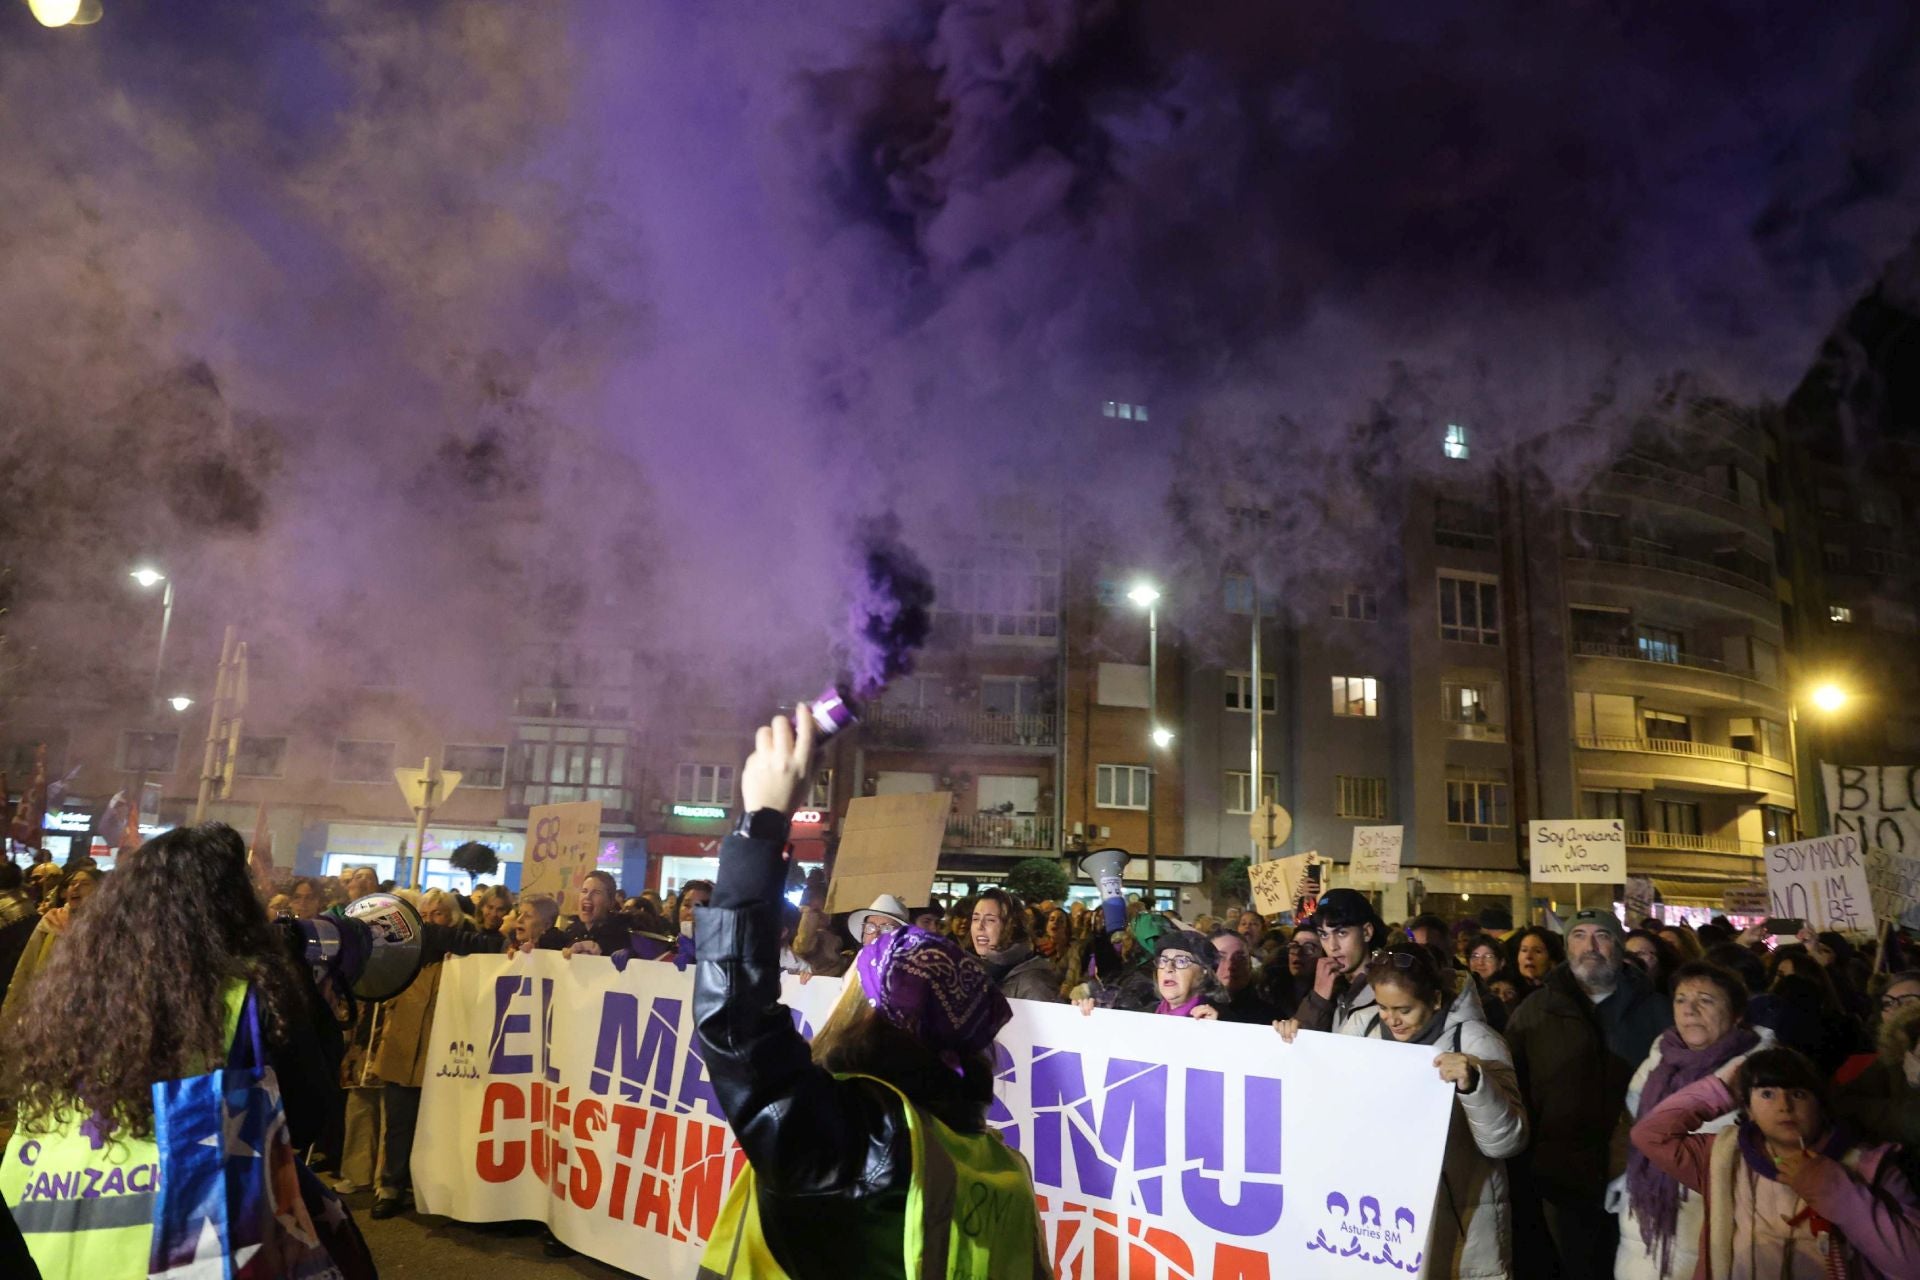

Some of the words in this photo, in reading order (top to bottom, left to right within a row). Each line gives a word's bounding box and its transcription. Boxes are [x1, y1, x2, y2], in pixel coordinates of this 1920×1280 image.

[1773, 849, 1806, 873] SOY
[1807, 835, 1860, 872] MAYOR
[488, 975, 561, 1083] EL
[1340, 1220, 1381, 1240] Asturies
[1384, 1230, 1402, 1244] 8M
